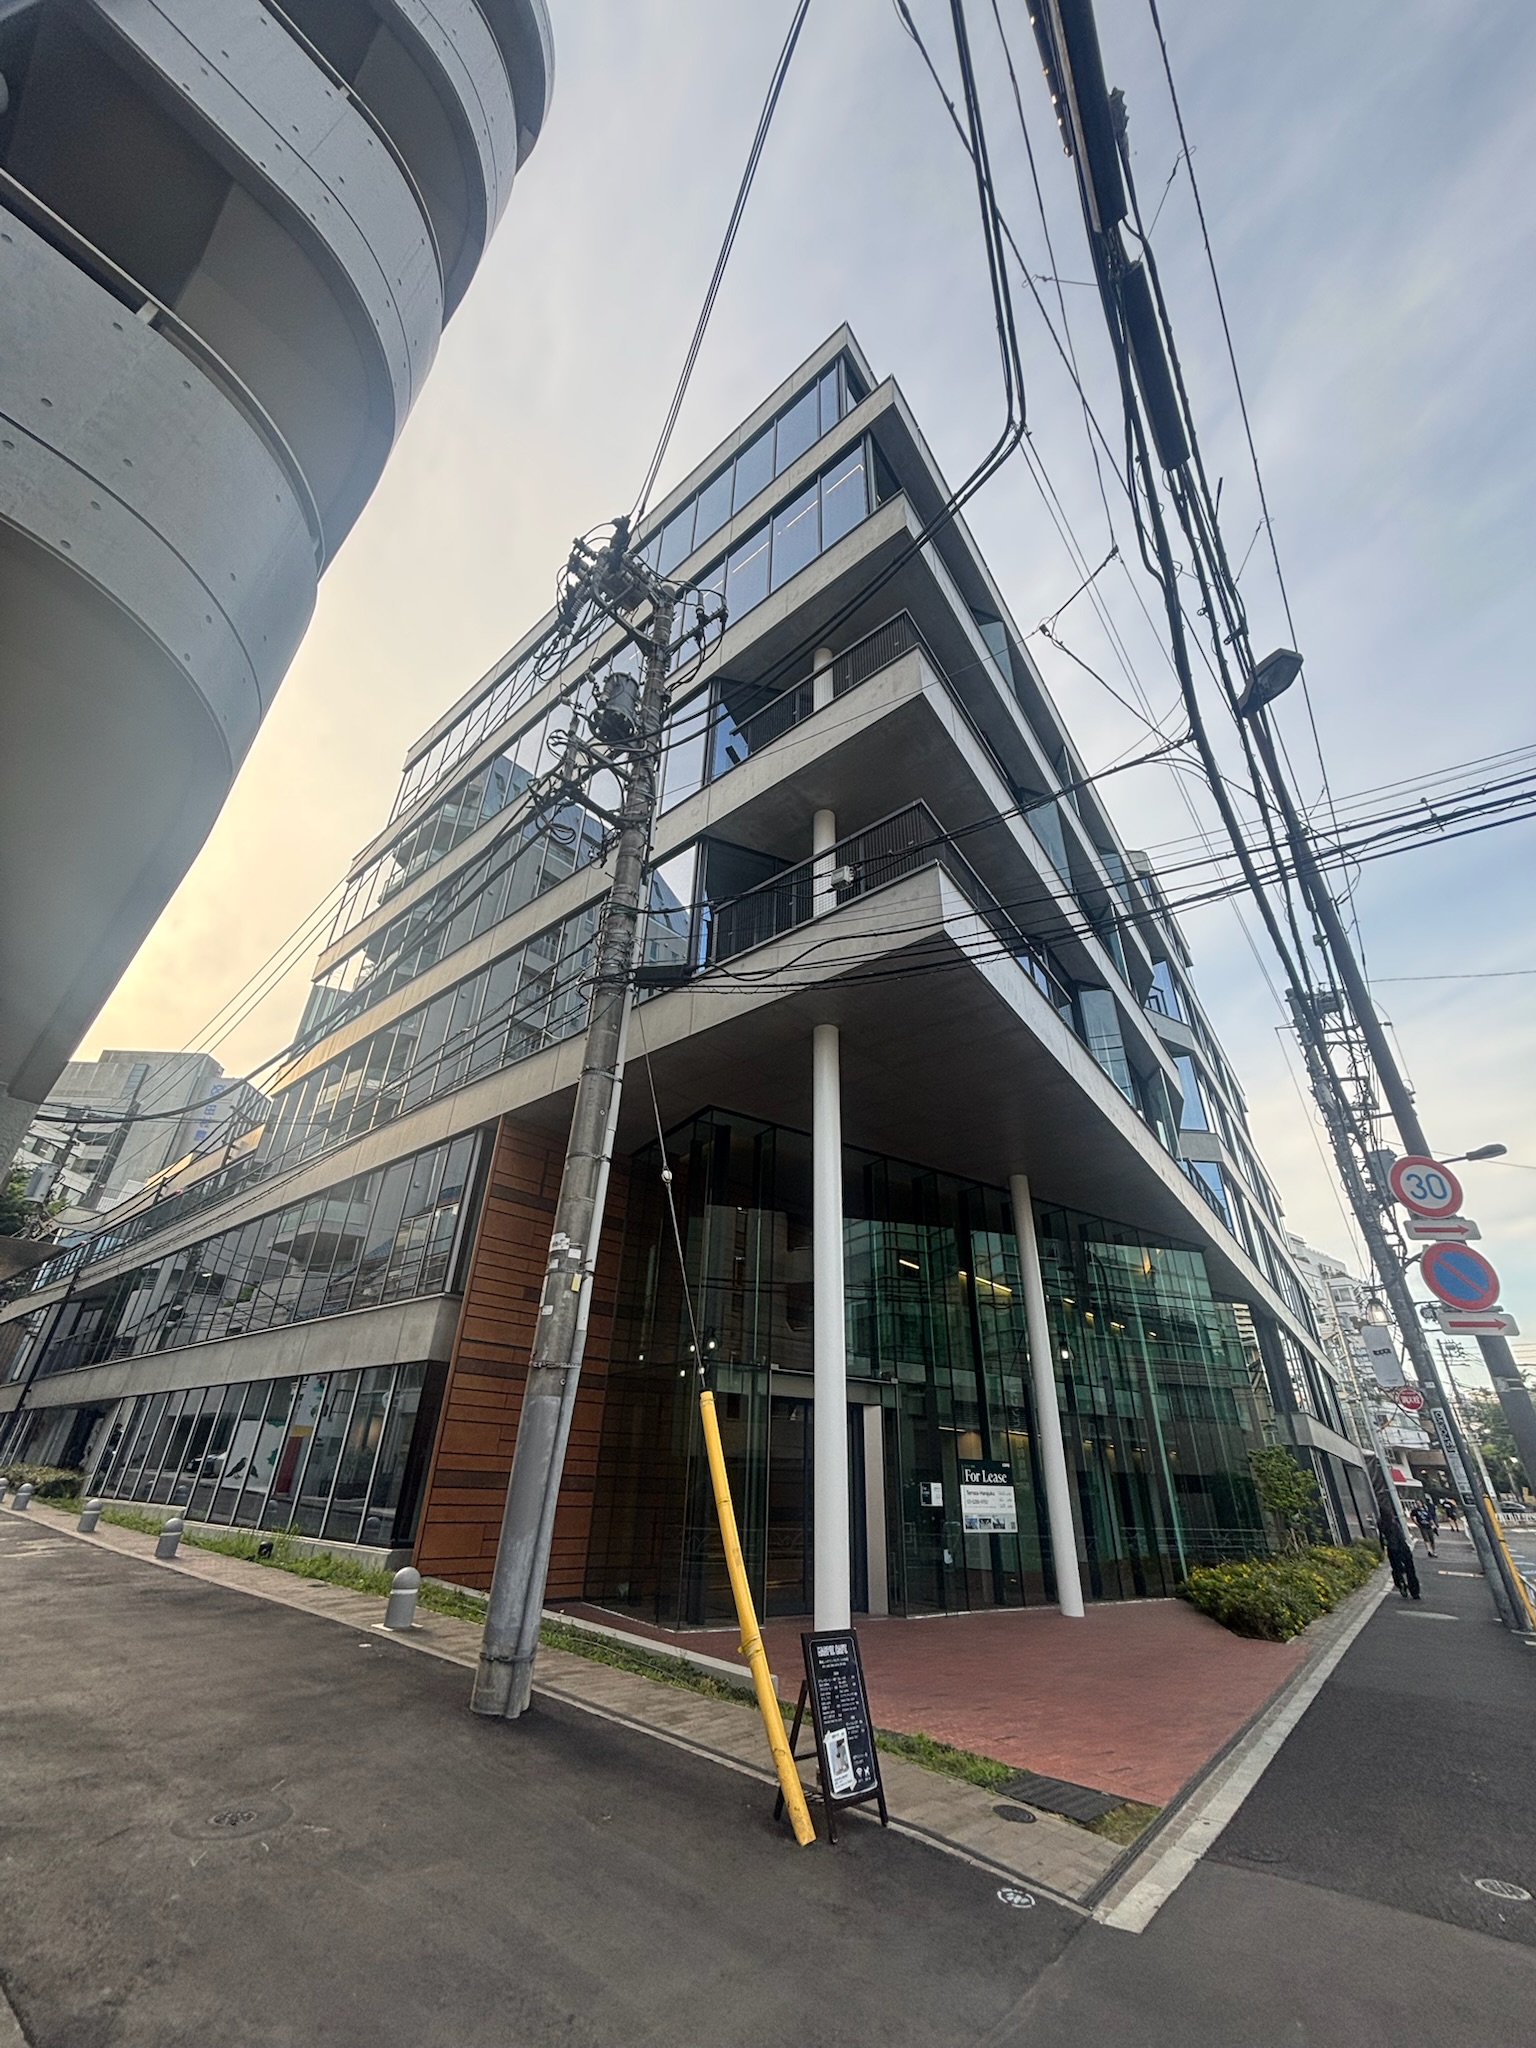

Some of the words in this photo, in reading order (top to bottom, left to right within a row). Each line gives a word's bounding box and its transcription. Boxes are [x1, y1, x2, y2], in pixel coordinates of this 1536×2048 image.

[1406, 1173, 1448, 1200] 30
[965, 1468, 980, 1482] For
[981, 1469, 1008, 1483] Lease
